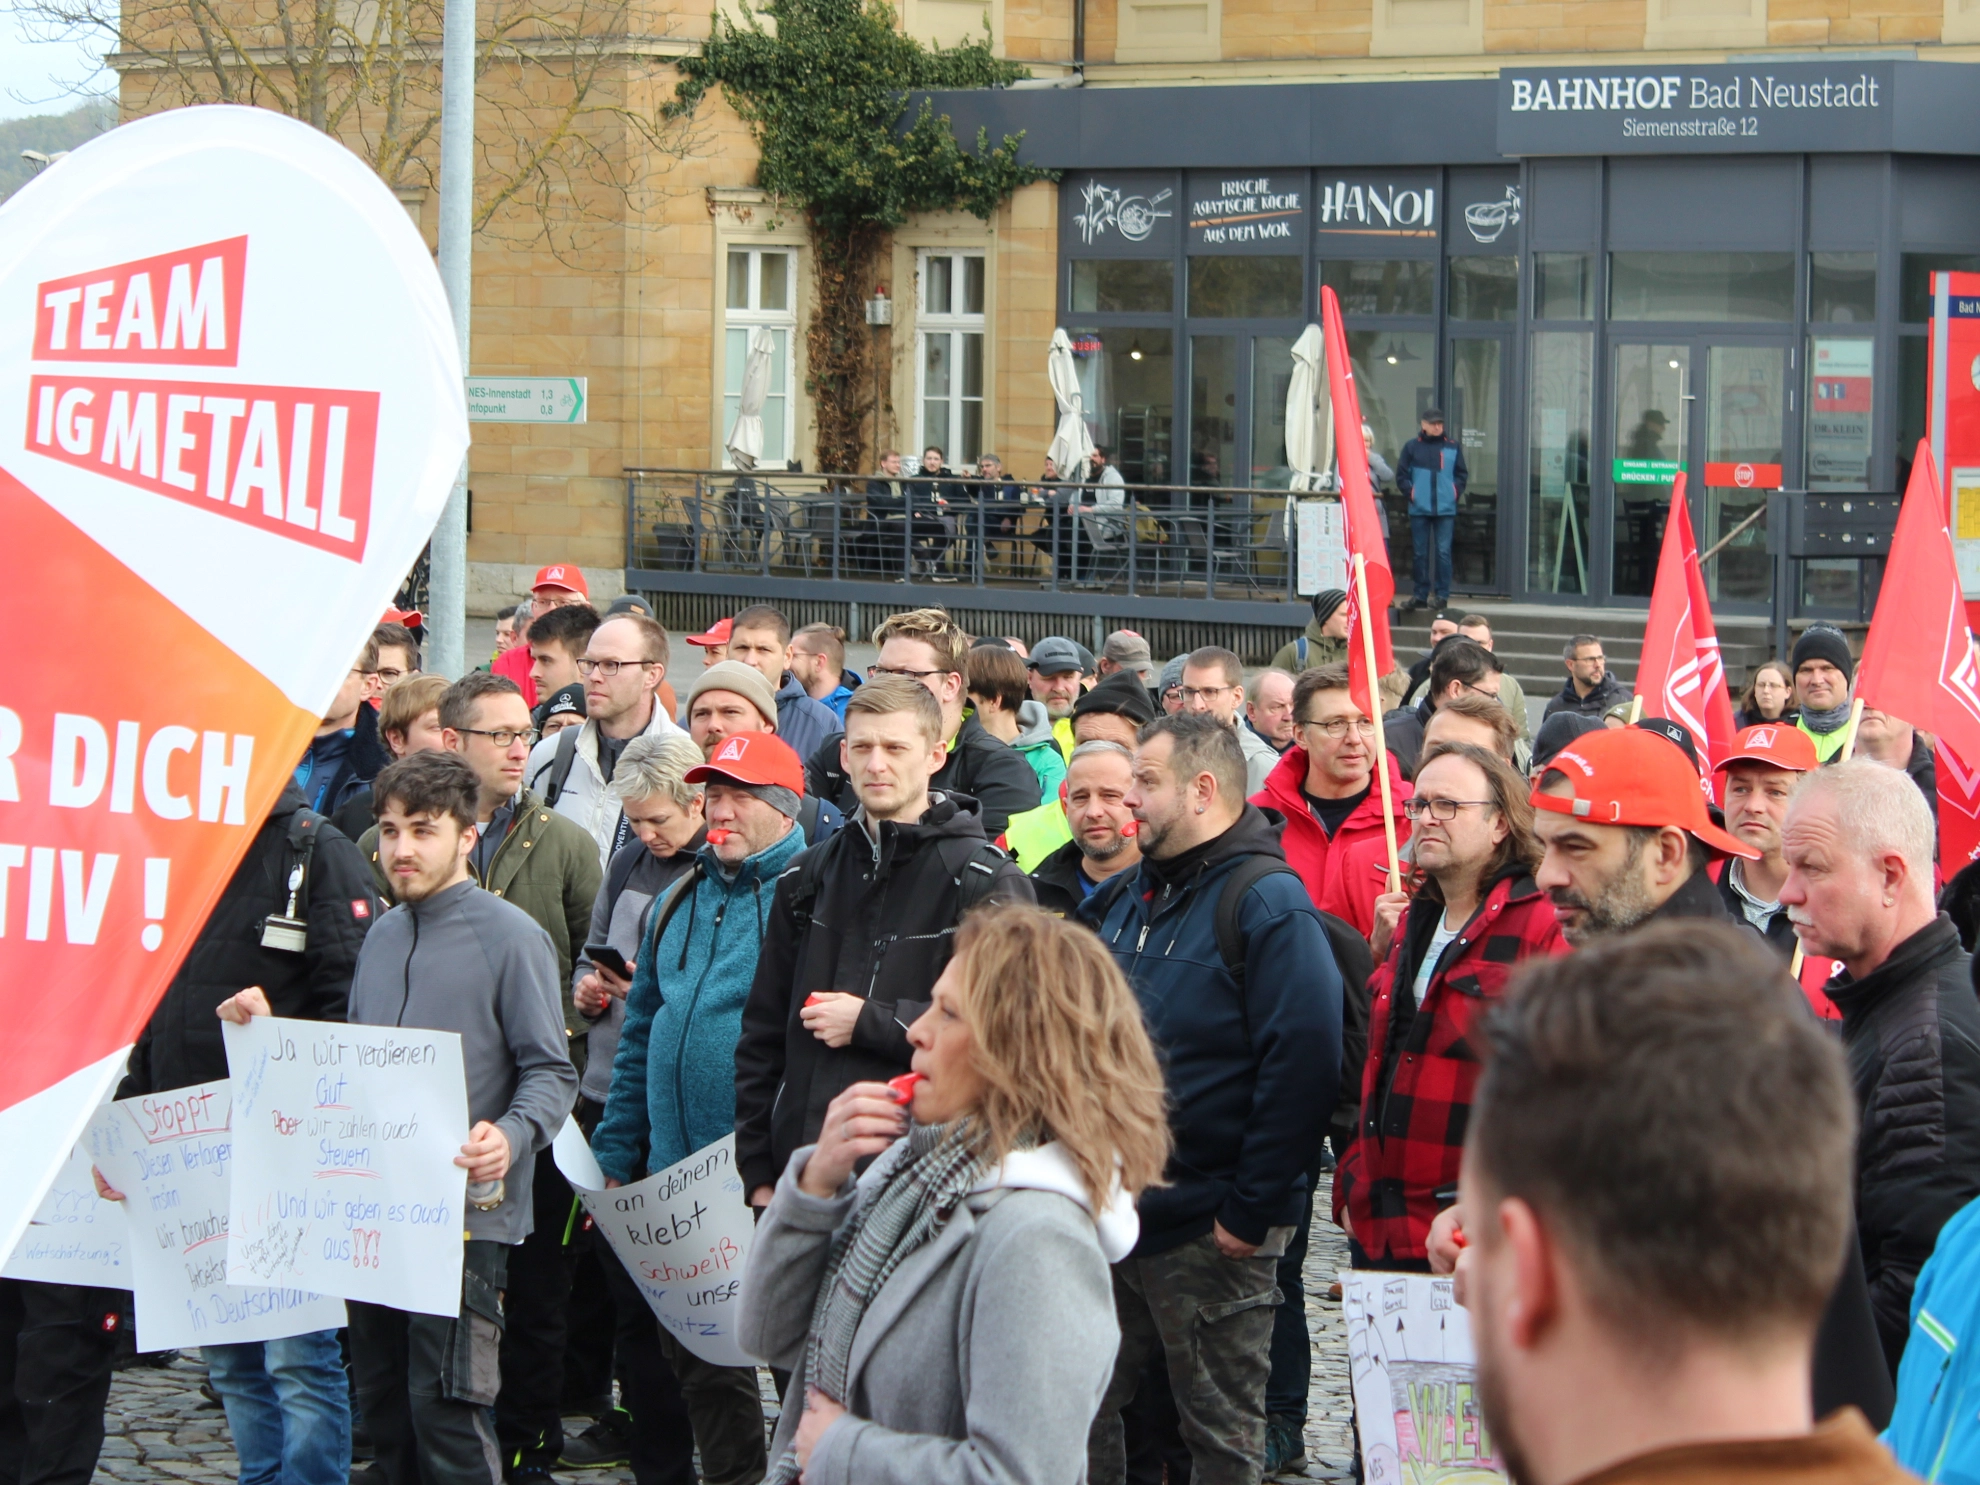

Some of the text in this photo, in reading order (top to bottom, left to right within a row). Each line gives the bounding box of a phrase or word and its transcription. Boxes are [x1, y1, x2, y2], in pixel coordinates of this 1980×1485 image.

[1511, 74, 1879, 112] BAHNHOF Bad Neustadt
[1622, 116, 1758, 137] Siemensstraße 12
[1221, 177, 1271, 197] FRISCHE
[1321, 181, 1434, 227] HANOI
[1193, 196, 1258, 217] ASIATISCHE
[1203, 221, 1291, 243] AUS DEM WOK
[44, 256, 226, 350] TEAM
[1958, 300, 1974, 313] Bad
[468, 387, 553, 401] NES-Innenstadt 1,3
[468, 402, 553, 416] Infopunkt 0,8
[36, 386, 357, 544] IG METALL
[1621, 471, 1656, 482] DRÜCKEN
[1661, 474, 1676, 483] PUS
[1736, 469, 1752, 481] STOP
[49, 713, 255, 826] DICH
[271, 1027, 436, 1068] Ja wir verdienen
[315, 1072, 348, 1106] Gut
[142, 1088, 217, 1135] Stoppt
[317, 1138, 370, 1167] Steuern
[615, 1194, 644, 1212] an
[658, 1148, 729, 1201] deinem
[277, 1188, 449, 1231] Und wir geben es auch
[626, 1200, 708, 1246] klebt
[180, 1209, 229, 1246] brauche
